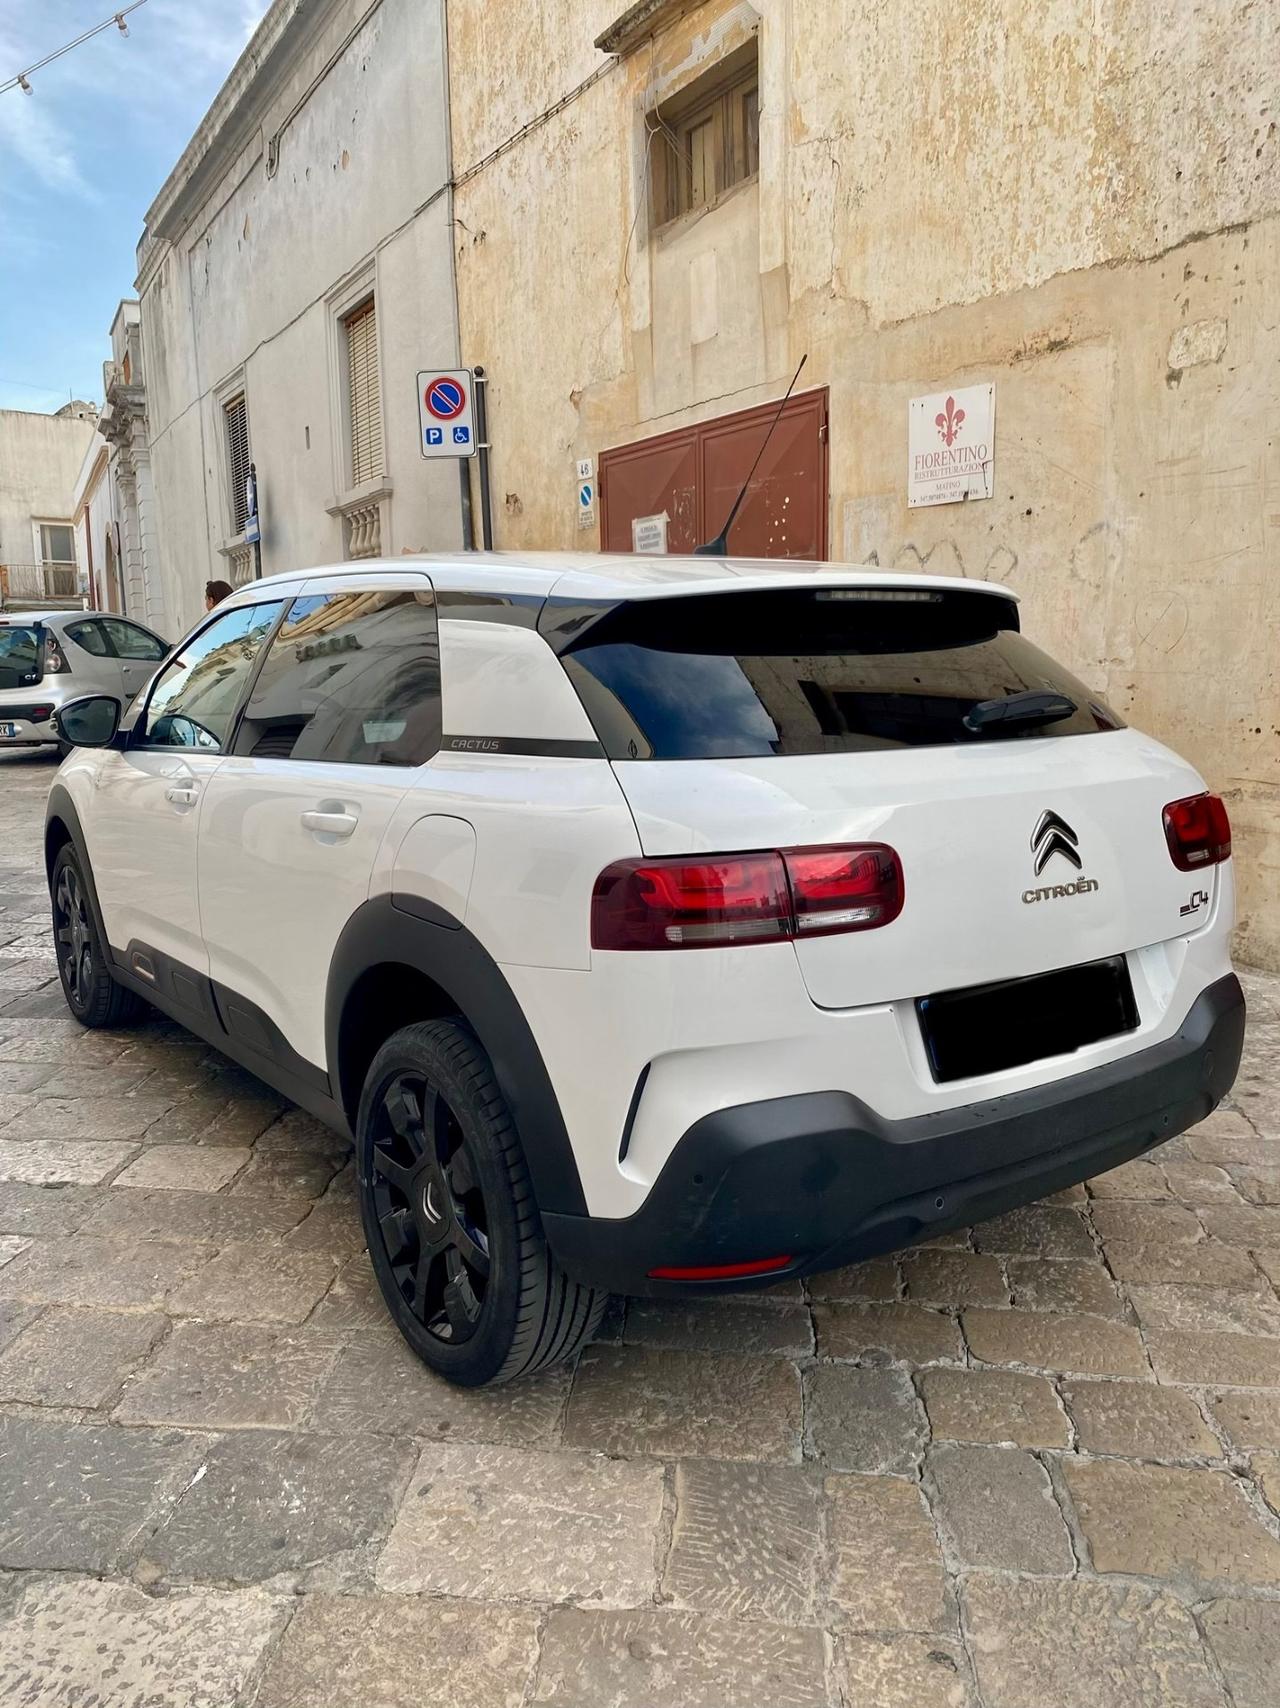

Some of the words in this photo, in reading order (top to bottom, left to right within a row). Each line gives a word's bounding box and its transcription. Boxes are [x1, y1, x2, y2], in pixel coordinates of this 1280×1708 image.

[429, 429, 440, 443] P
[915, 444, 988, 471] FIORENTINO
[451, 739, 499, 750] CACTUS
[1190, 890, 1209, 908] C4
